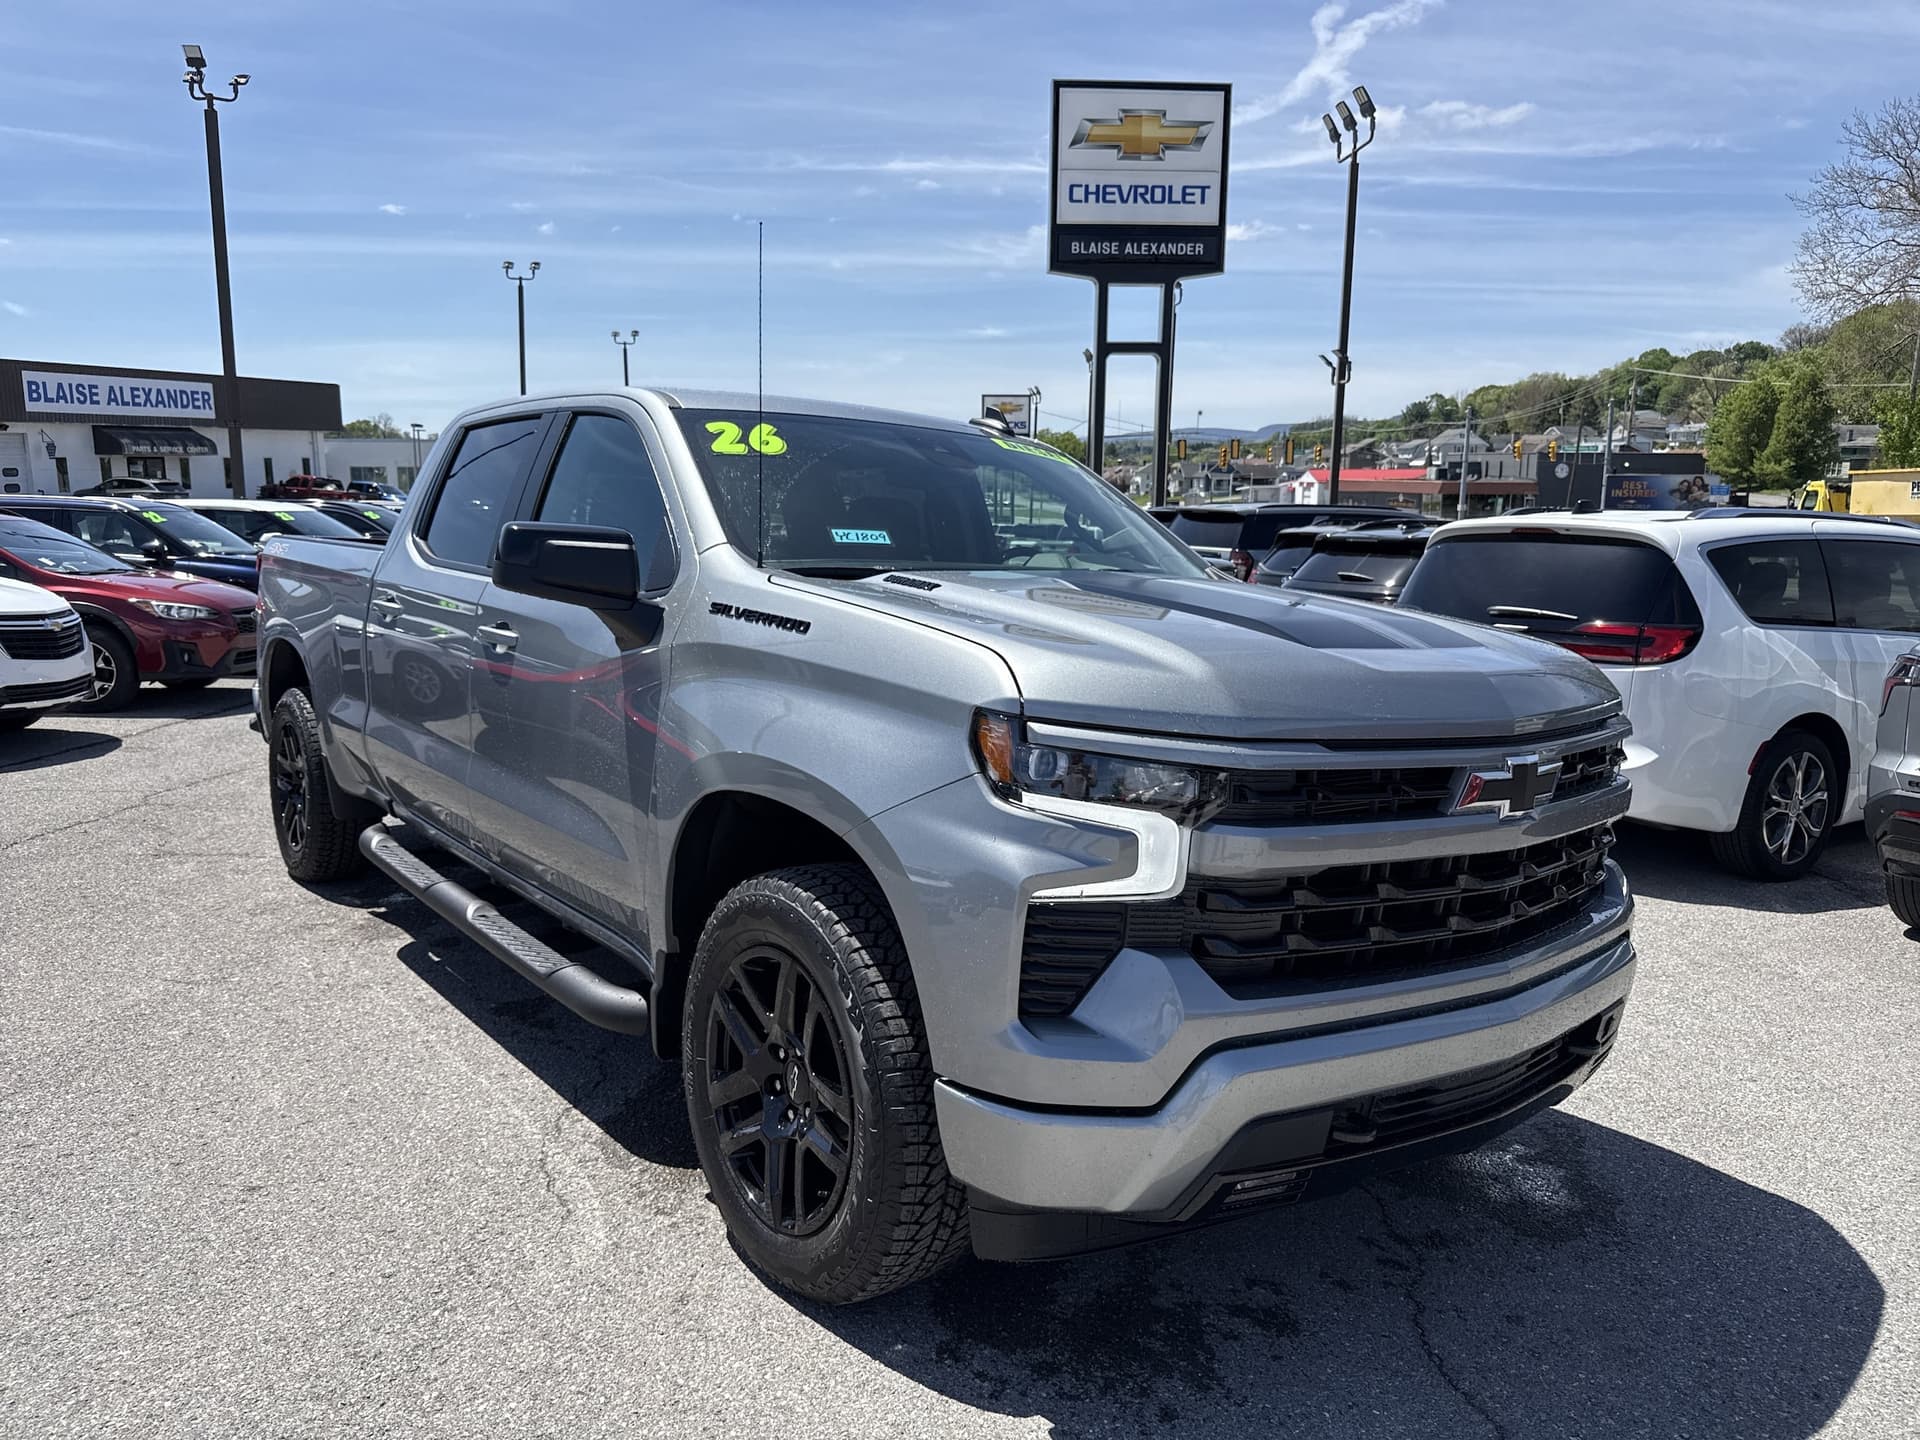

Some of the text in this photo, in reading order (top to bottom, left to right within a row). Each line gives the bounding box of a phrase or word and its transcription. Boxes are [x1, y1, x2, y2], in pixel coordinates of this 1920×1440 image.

[1068, 184, 1211, 205] CHEVROLET
[1071, 242, 1204, 256] BLAISE ALEXANDER
[26, 380, 213, 411] BLAISE ALEXANDER
[704, 421, 788, 455] 26
[1611, 489, 1658, 498] INSURED
[1622, 481, 1649, 489] REST
[708, 602, 812, 635] SILVERADO
